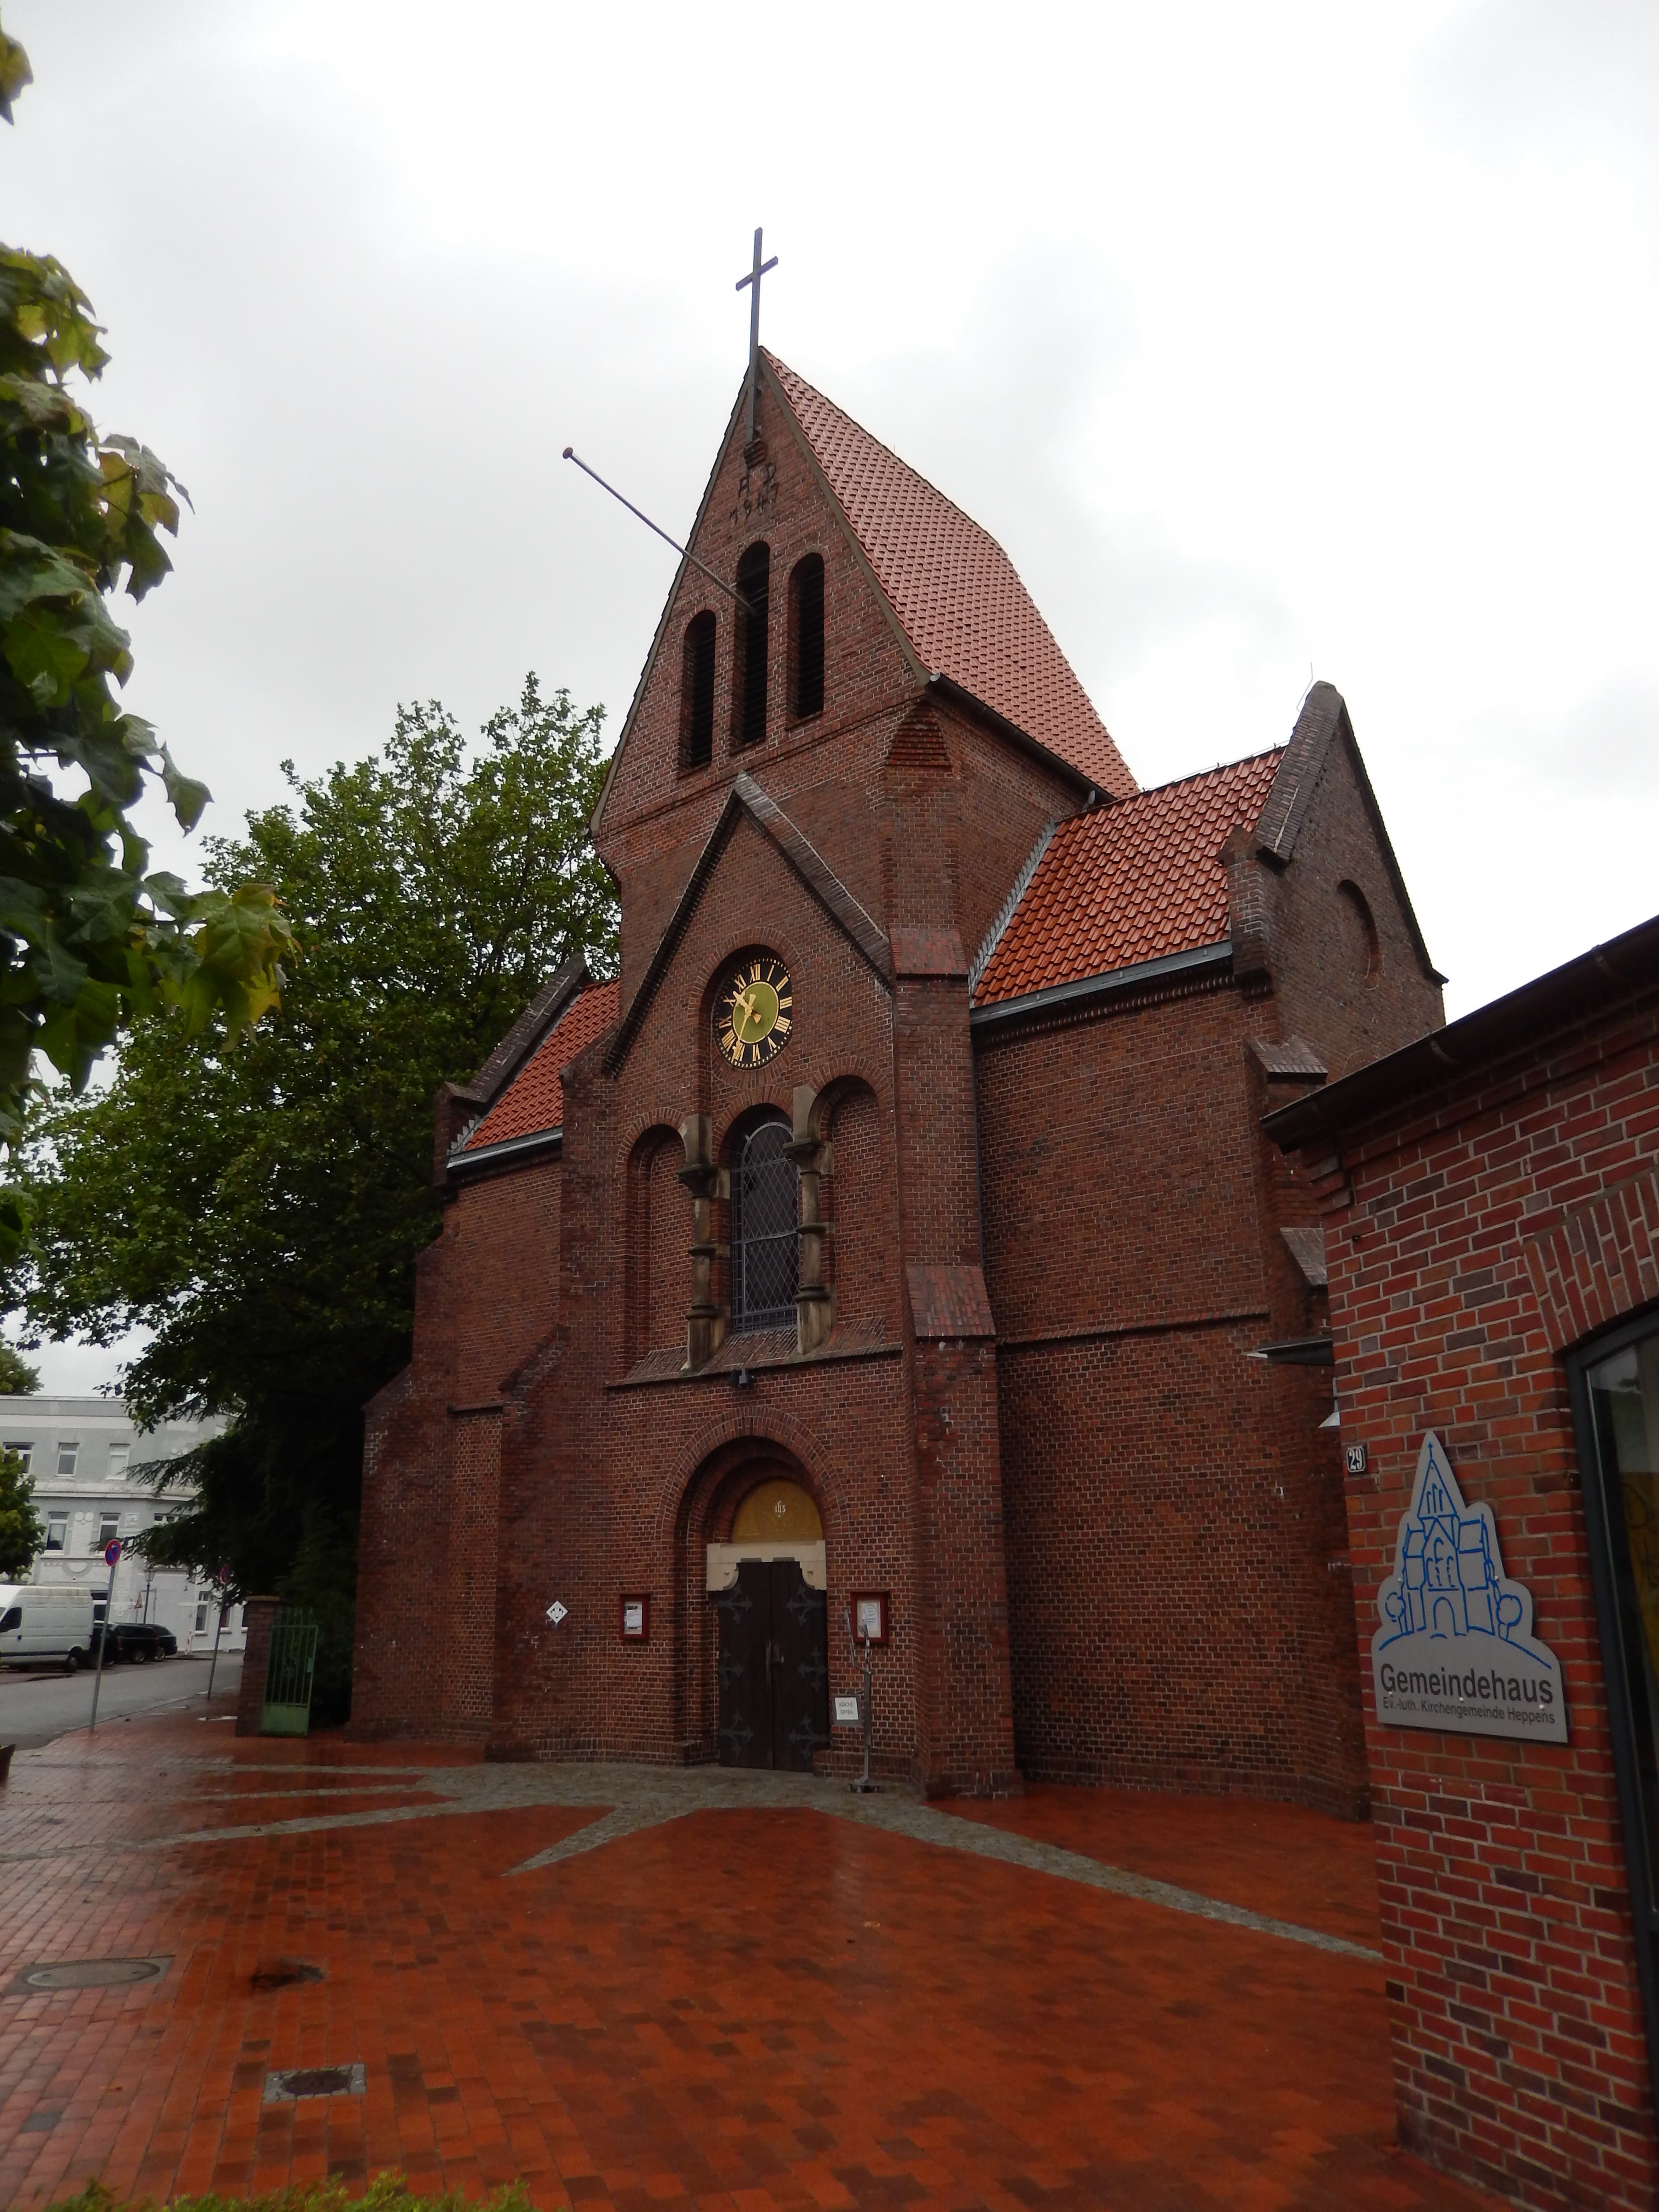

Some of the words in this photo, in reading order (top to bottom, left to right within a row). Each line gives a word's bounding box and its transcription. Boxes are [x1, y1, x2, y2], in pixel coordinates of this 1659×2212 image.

[1349, 1448, 1362, 1470] 29
[1380, 1663, 1553, 1704] Gemeindehaus
[1383, 1696, 1418, 1711] Ev.-luth.
[1421, 1700, 1504, 1720] Kirchengemeinde
[1508, 1707, 1556, 1725] Heppens
